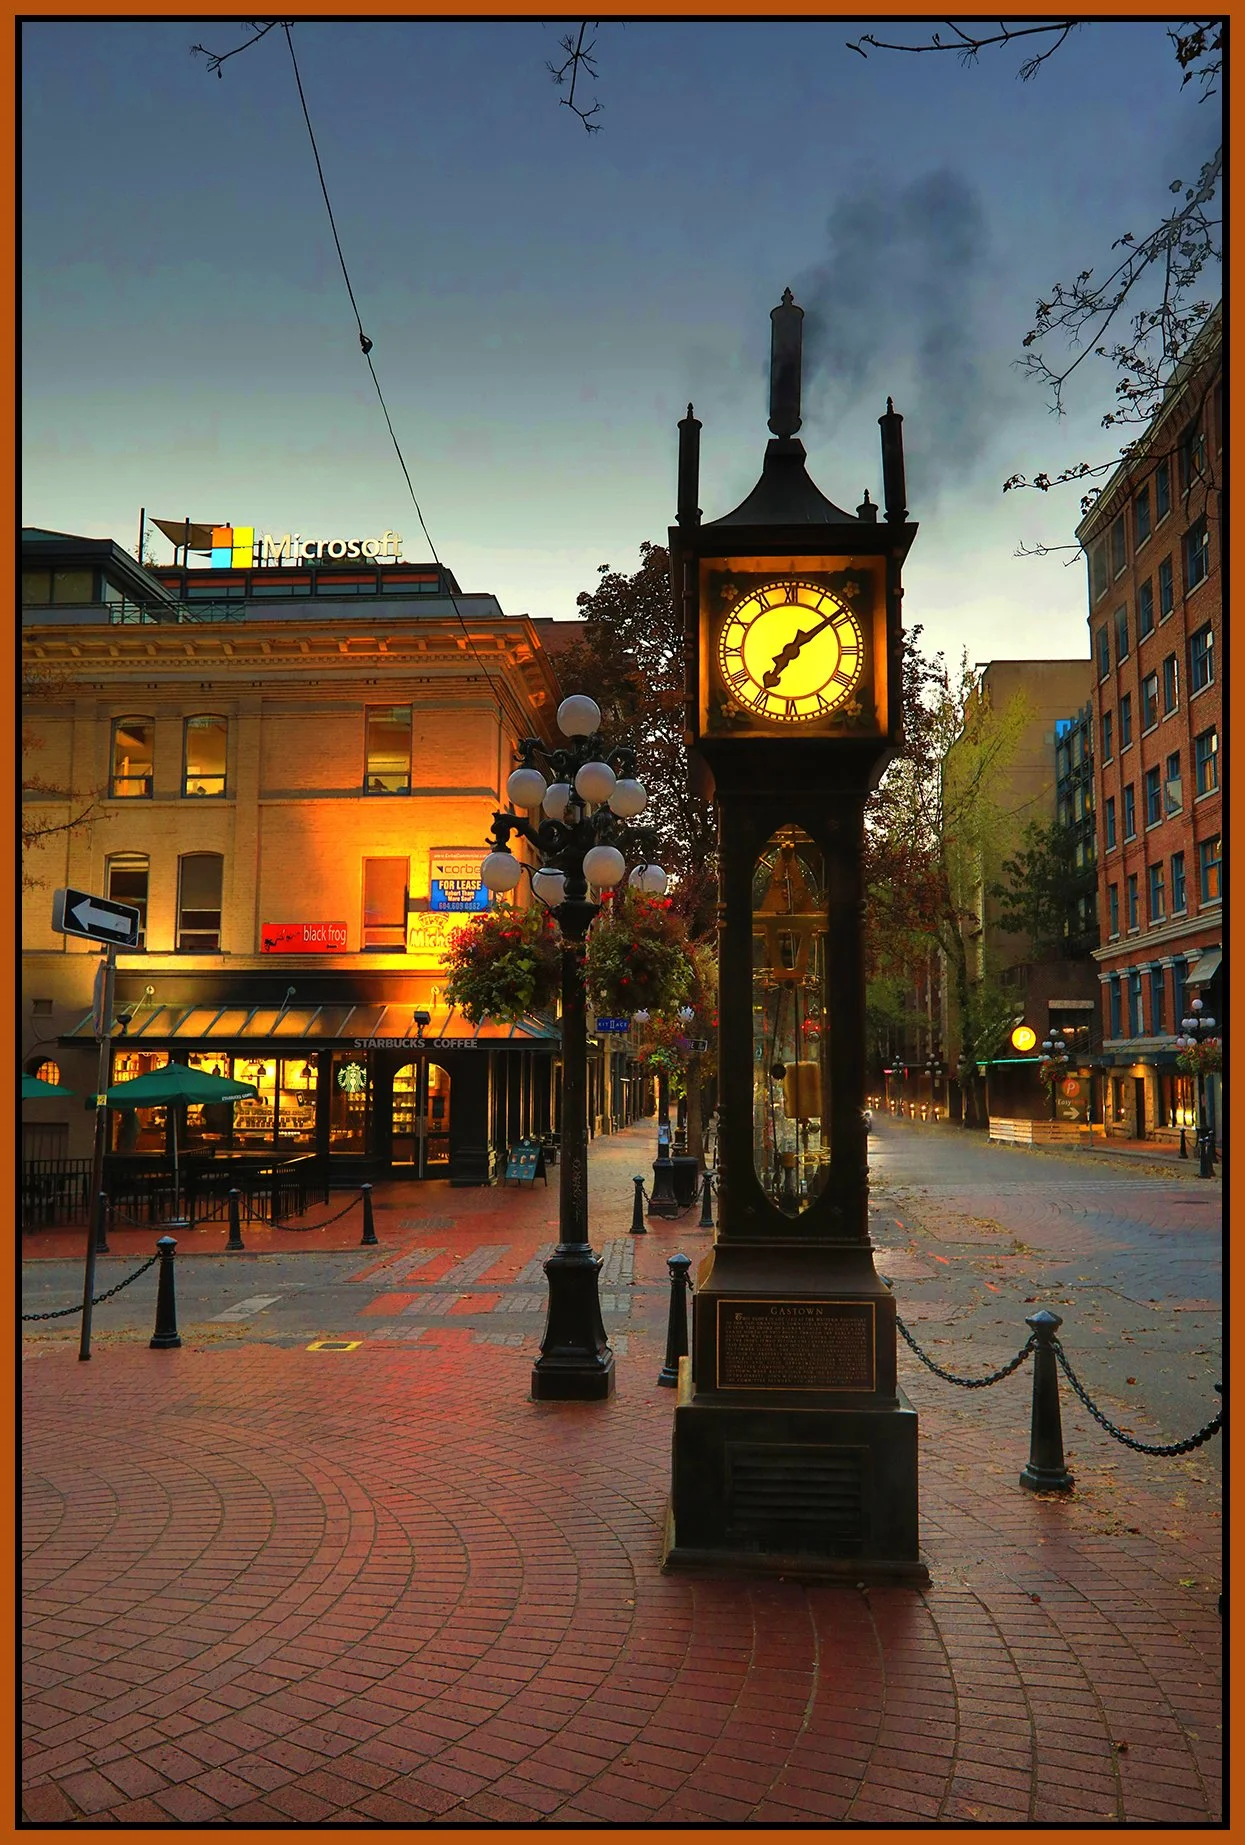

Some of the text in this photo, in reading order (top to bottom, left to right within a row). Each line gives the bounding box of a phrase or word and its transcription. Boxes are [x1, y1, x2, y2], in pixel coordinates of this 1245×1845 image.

[262, 530, 403, 560] Microsoft
[444, 864, 481, 874] corbe
[438, 880, 481, 890] FOR LEASE
[303, 925, 346, 945] black frog
[353, 1038, 478, 1049] STARBUCKS COFFEE
[770, 1306, 824, 1316] GASTOWN
